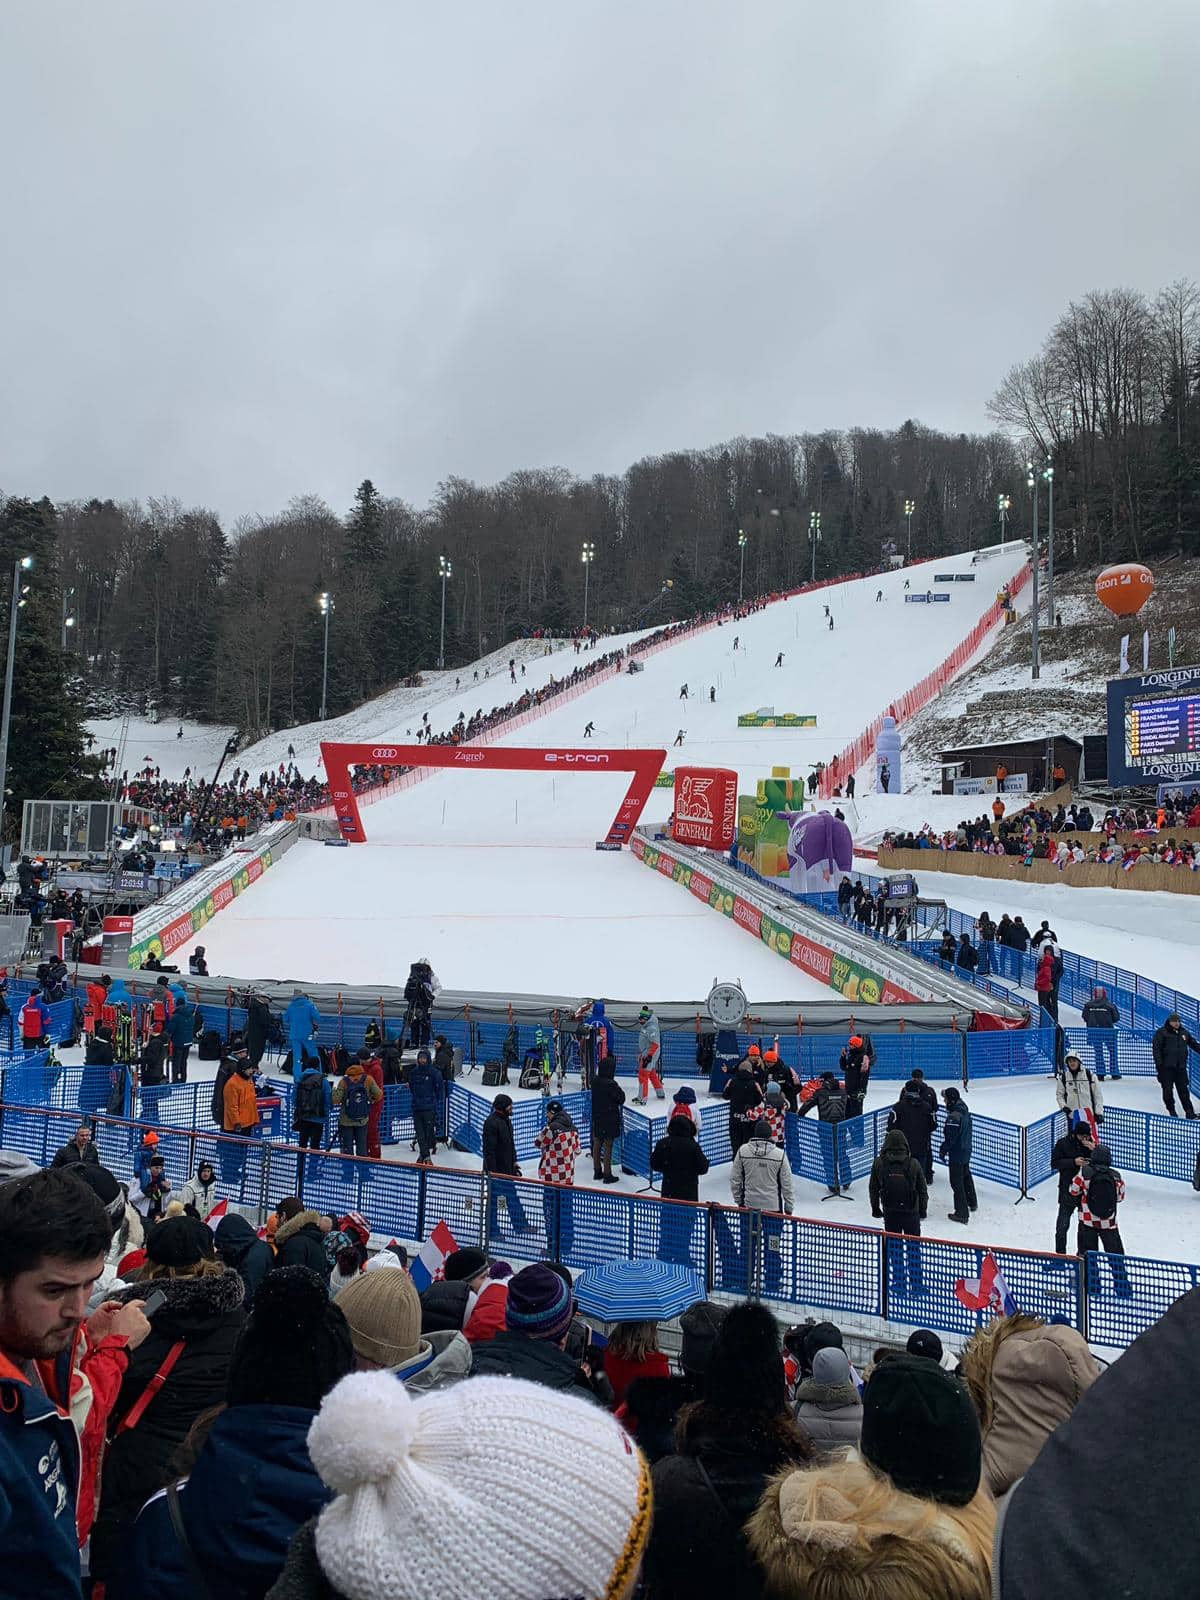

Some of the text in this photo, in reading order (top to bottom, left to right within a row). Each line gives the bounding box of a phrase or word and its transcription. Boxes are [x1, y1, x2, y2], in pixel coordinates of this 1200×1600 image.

[1141, 668, 1200, 686] LONGINE
[454, 752, 609, 762] Zagreb e-tron
[1142, 762, 1200, 776] LONGINE
[722, 780, 736, 840] GENERALI
[676, 822, 712, 842] GENERALI
[800, 945, 831, 977] GENERALI
